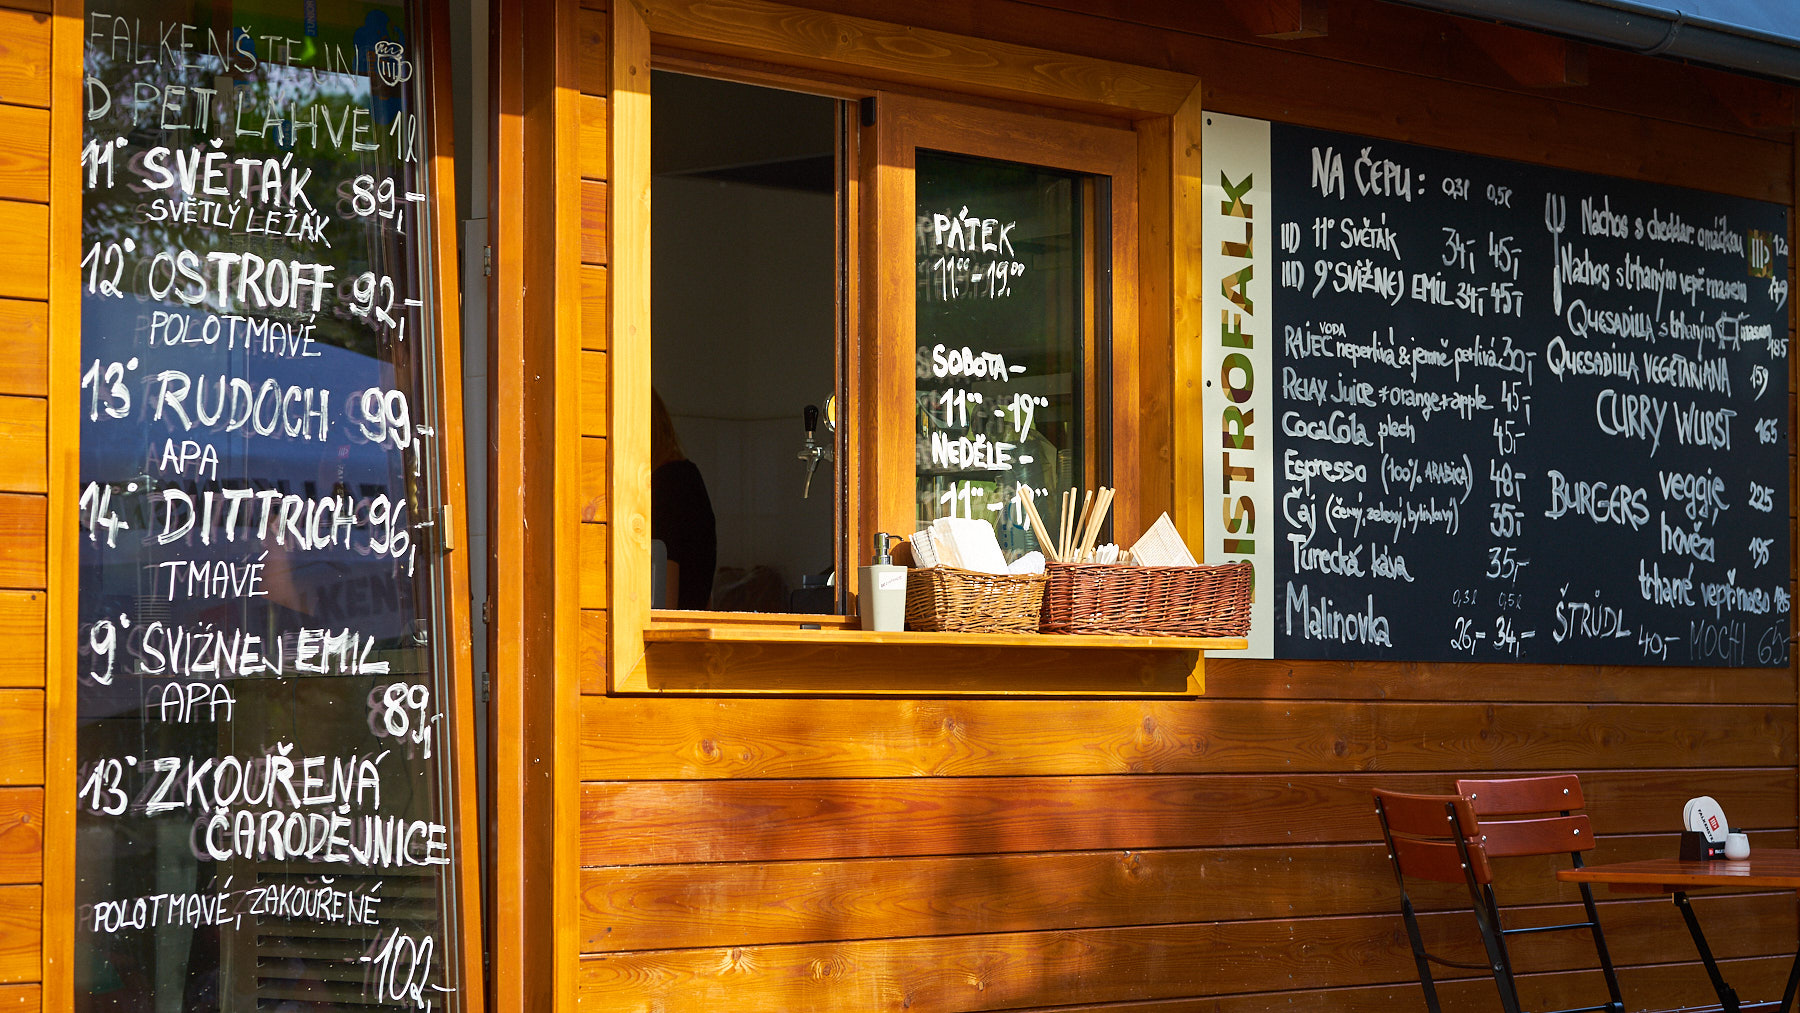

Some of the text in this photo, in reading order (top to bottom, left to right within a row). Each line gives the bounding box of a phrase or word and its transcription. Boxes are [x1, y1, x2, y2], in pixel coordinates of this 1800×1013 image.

[133, 83, 217, 134] PET
[142, 137, 316, 211] SVĚTÁK
[1311, 146, 1345, 200] NA
[146, 198, 331, 248] SVĚTLÝ LEŽÁK
[934, 205, 1016, 258] PÁTEK
[1581, 195, 1628, 239] Nachos
[1635, 217, 1644, 240] s
[148, 250, 335, 312] OSTROFF
[1561, 242, 1609, 291] Nachos
[150, 311, 321, 357] POLOTMAVÉ
[1319, 322, 1346, 338] VODA
[1658, 321, 1669, 337] s
[154, 370, 330, 442] RUDOCH
[1221, 169, 1254, 603] ISTROFALK
[1378, 413, 1415, 453] plech
[1597, 388, 1667, 457] CURRY
[1673, 401, 1737, 450] WURST
[160, 438, 218, 480] APA
[1284, 448, 1367, 496] Espresso
[158, 488, 357, 550] DITTRICH
[1283, 485, 1316, 549] Čaj
[1545, 470, 1649, 531] BURGERS
[1659, 467, 1729, 520] veggie
[159, 551, 268, 601] TMAVÉ
[1287, 533, 1365, 577] Turecká
[1371, 542, 1414, 582] káva
[1638, 558, 1695, 608] trhané
[1286, 580, 1392, 647] Malinovka
[140, 620, 282, 679] SVIŽNEJ
[296, 626, 389, 675] EMIL
[1690, 619, 1746, 667] MOCHI
[161, 682, 236, 722] APA
[146, 742, 390, 816] ZKOUŘENÁ
[206, 803, 450, 867] ČARODĚJNICE
[246, 875, 382, 925] ZAKOUŘENÉ
